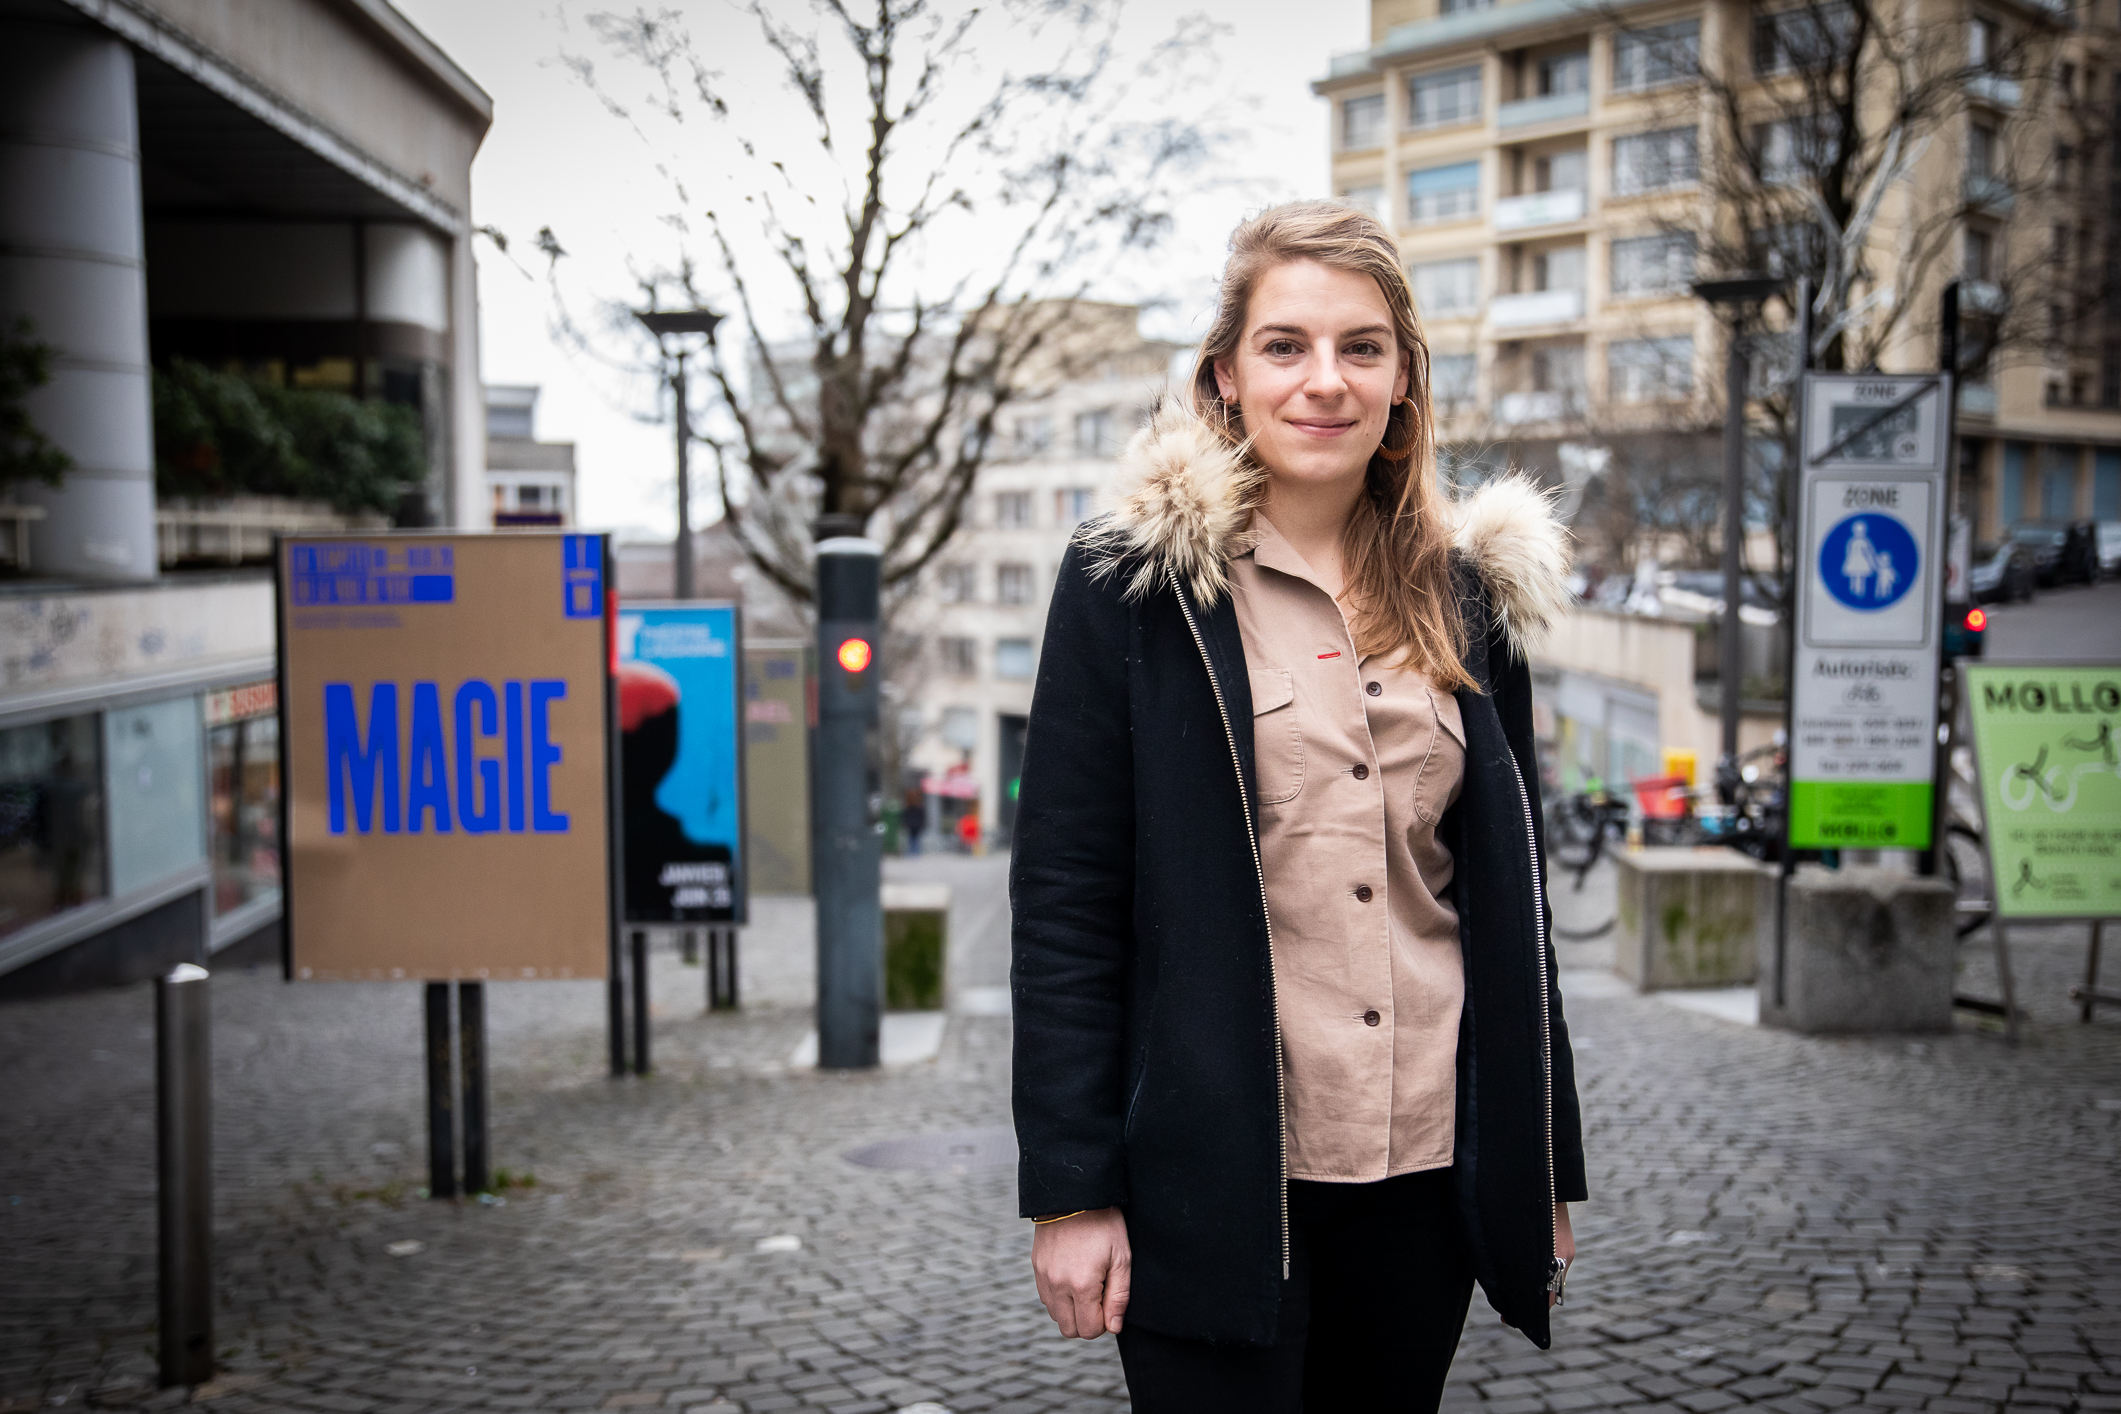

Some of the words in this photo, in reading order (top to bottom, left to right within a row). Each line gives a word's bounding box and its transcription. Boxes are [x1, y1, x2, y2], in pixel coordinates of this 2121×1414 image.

[1843, 487, 1900, 507] ZONE
[1984, 682, 2121, 712] MOLLO
[325, 680, 569, 834] MAGIE
